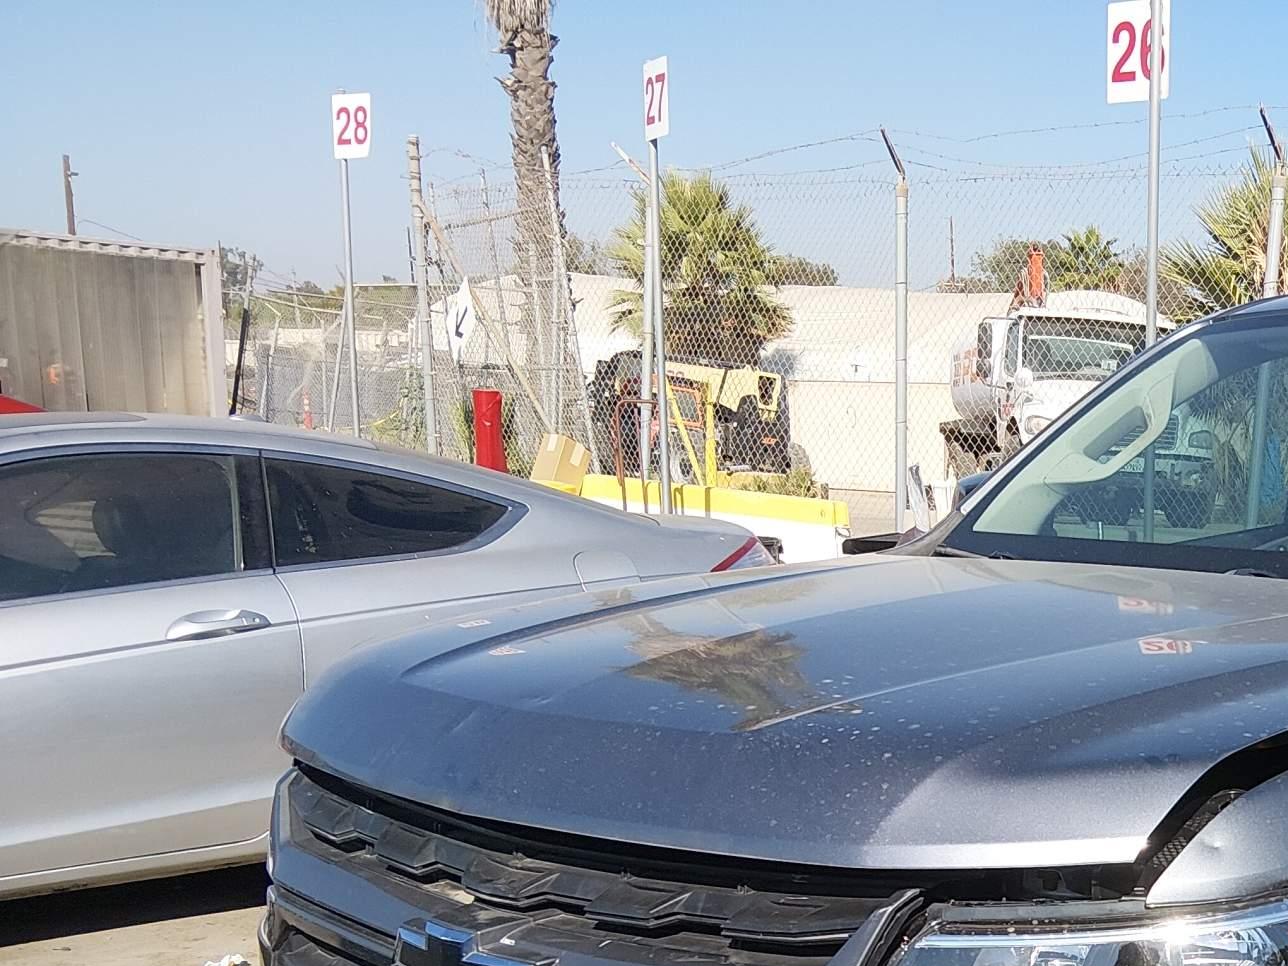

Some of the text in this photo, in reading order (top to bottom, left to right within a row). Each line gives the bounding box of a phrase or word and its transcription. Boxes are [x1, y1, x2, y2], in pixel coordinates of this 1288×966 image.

[1112, 18, 1165, 82] 26
[336, 105, 368, 145] 28
[645, 72, 665, 126] 27
